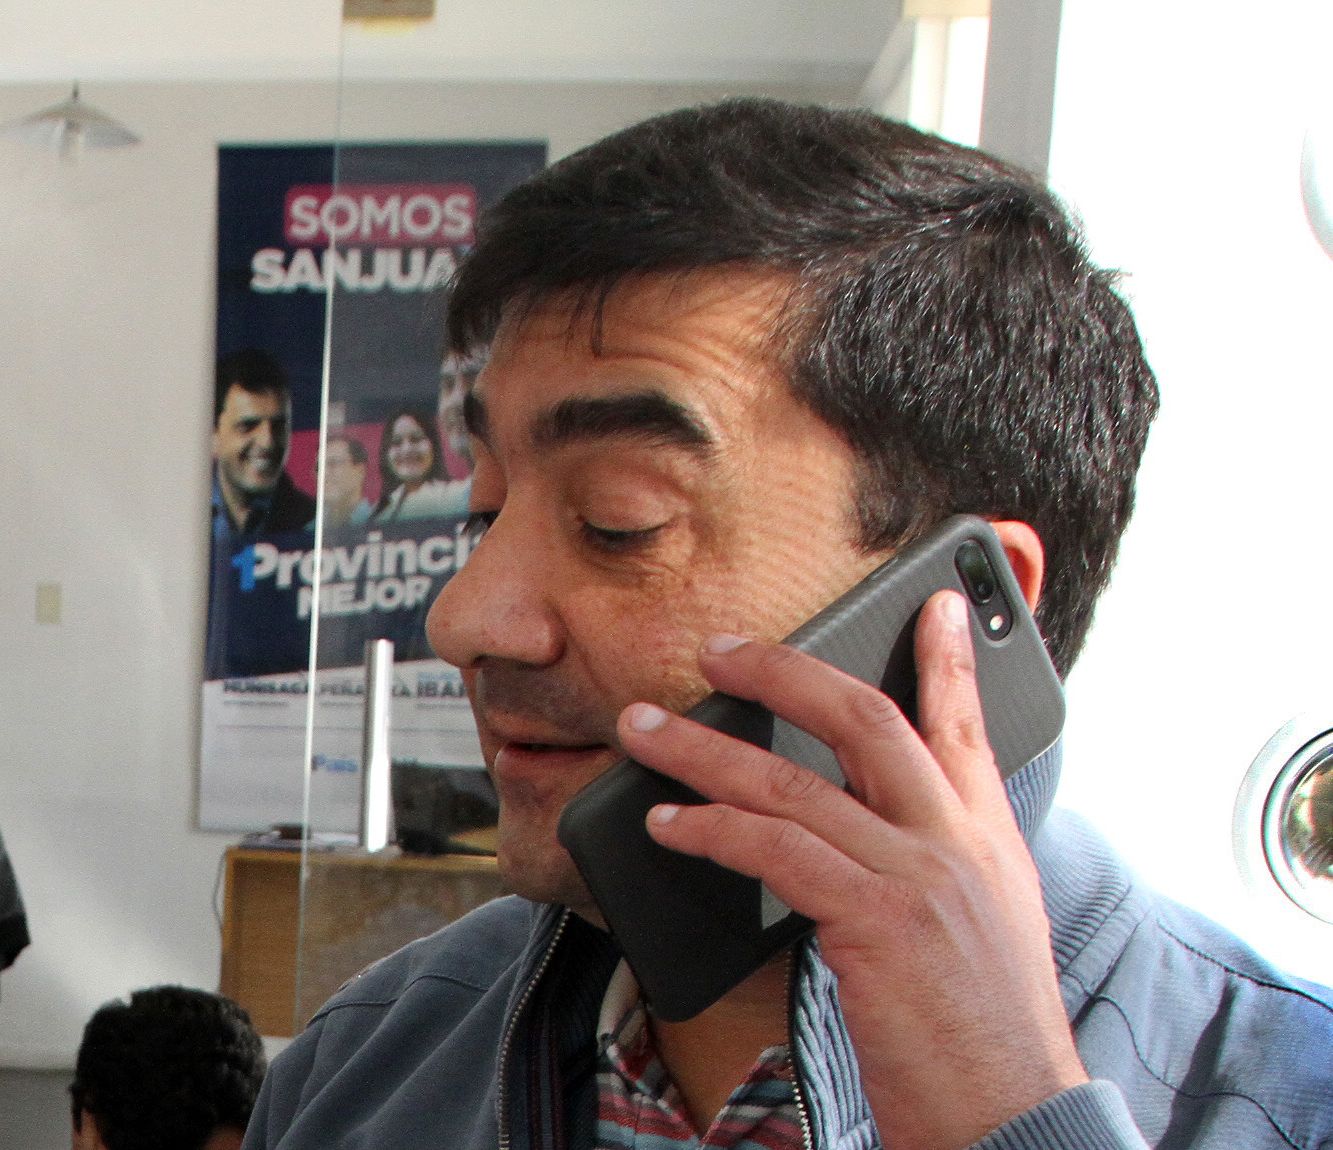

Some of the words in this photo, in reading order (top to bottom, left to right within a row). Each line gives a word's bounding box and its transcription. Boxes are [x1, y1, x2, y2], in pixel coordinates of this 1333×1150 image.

[289, 194, 474, 240] SOMOS
[250, 247, 459, 293] SANJUA
[297, 575, 432, 620] MEJOR
